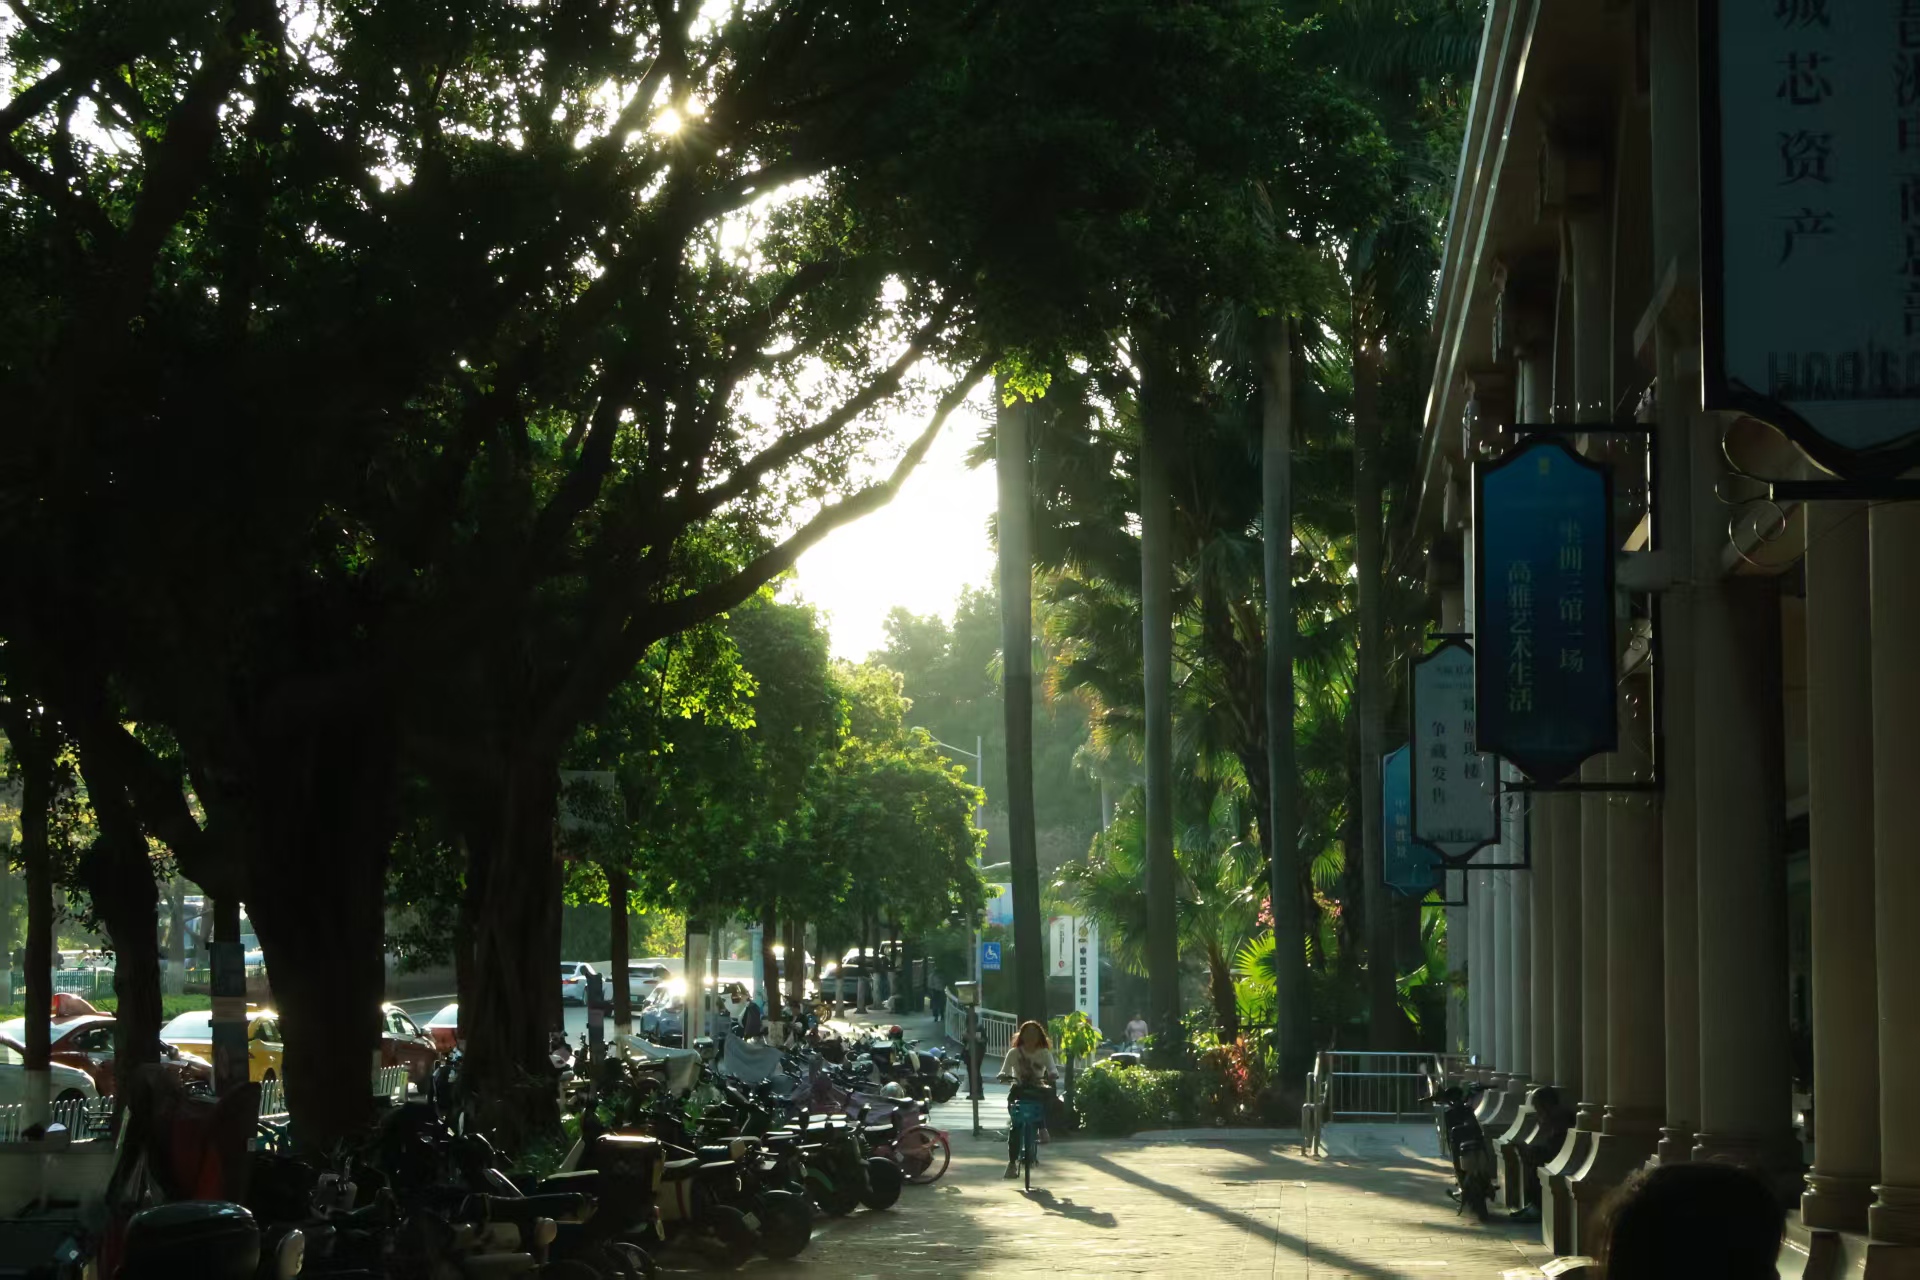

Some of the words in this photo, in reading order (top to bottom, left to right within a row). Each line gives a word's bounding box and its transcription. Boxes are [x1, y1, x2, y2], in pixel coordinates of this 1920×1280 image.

[1507, 560, 1532, 713] 高雅艺术生活
